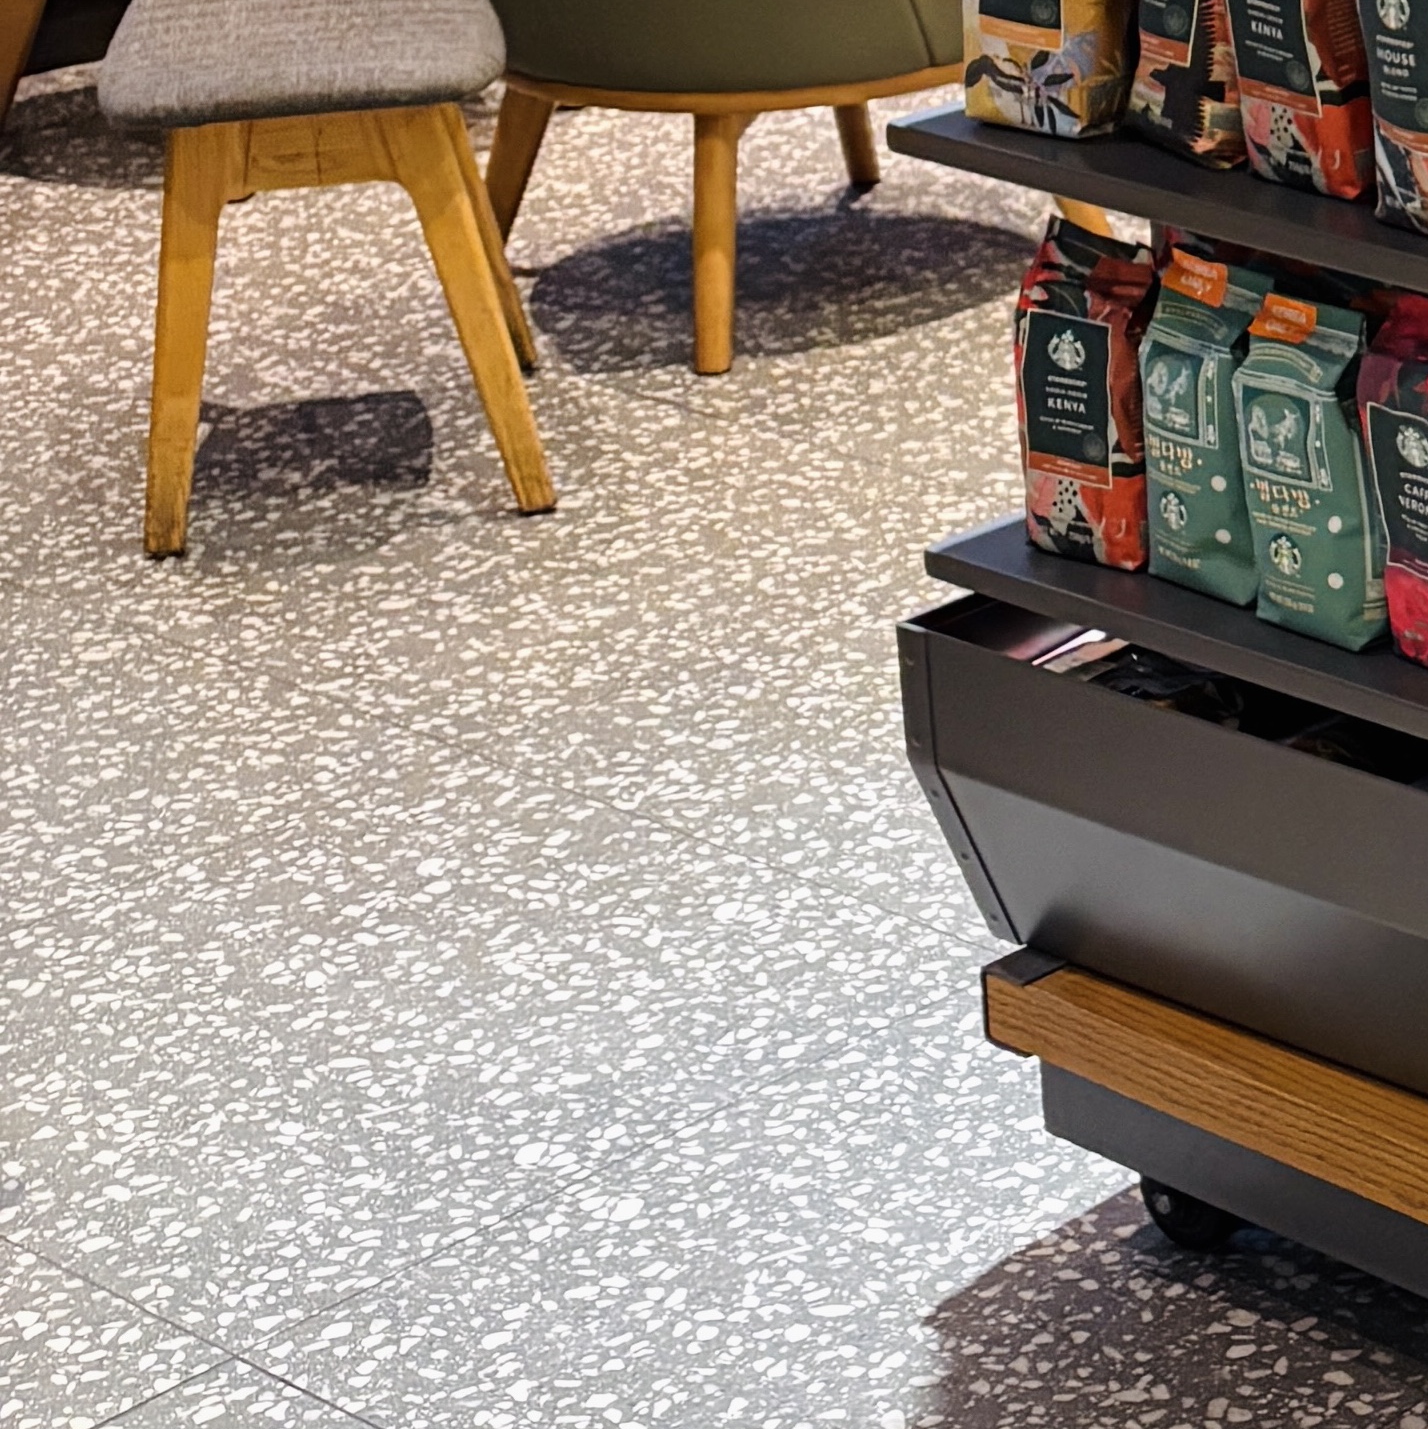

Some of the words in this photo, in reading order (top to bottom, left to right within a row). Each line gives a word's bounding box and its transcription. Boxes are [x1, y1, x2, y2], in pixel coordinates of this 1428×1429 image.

[1251, 20, 1284, 40] KENYA
[1376, 49, 1416, 67] HOUSE
[1047, 397, 1087, 415] KENYA
